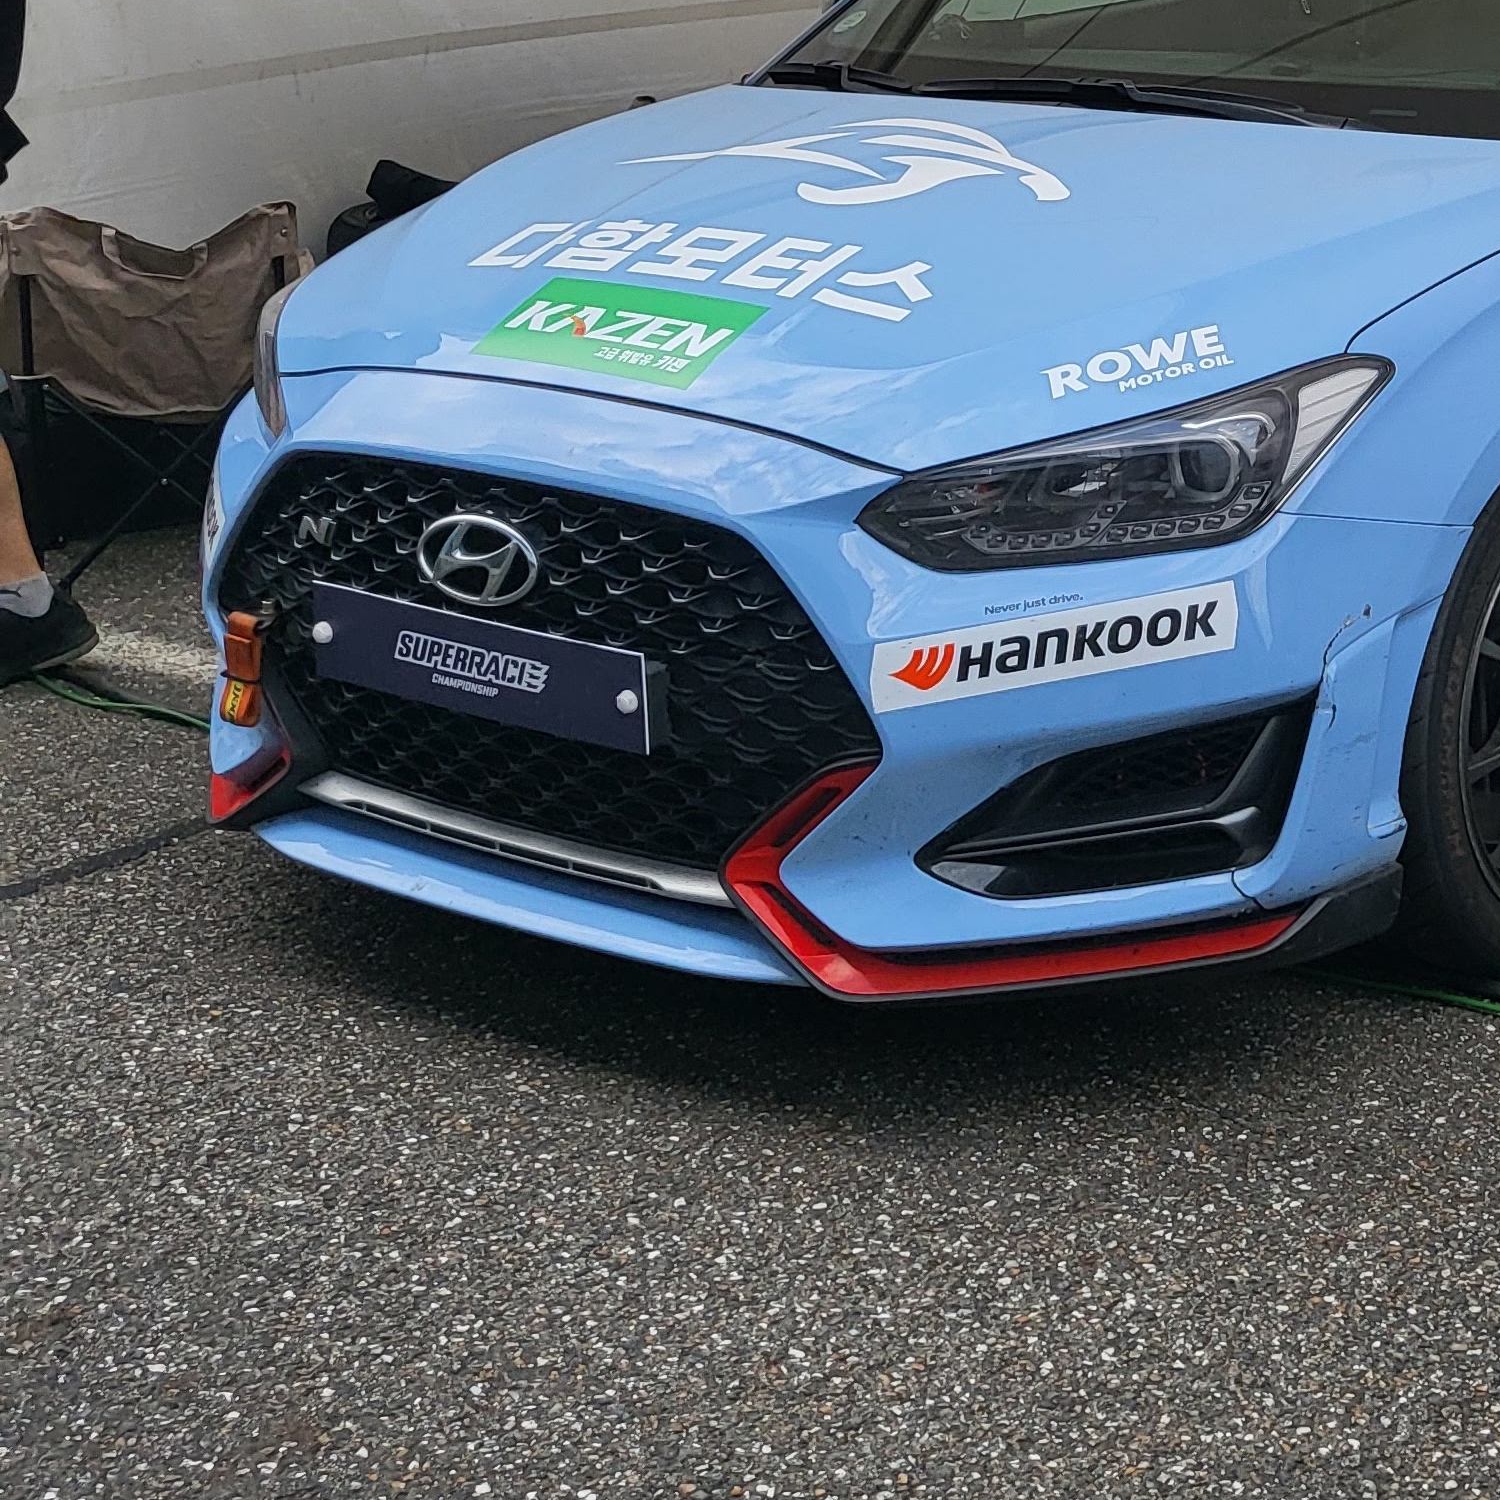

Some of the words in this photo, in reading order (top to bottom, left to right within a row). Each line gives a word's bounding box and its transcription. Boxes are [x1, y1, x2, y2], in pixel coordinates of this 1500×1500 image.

[468, 219, 933, 322] 다함모터스
[504, 300, 735, 358] KAZEN
[1040, 324, 1225, 399] ROWE
[1118, 362, 1197, 393] MOTOR
[1199, 353, 1235, 370] OIL
[983, 601, 1020, 616] Never
[1022, 597, 1048, 611] just
[396, 631, 548, 692] SUPERRACE
[431, 672, 499, 698] CHAMPIONSHIP
